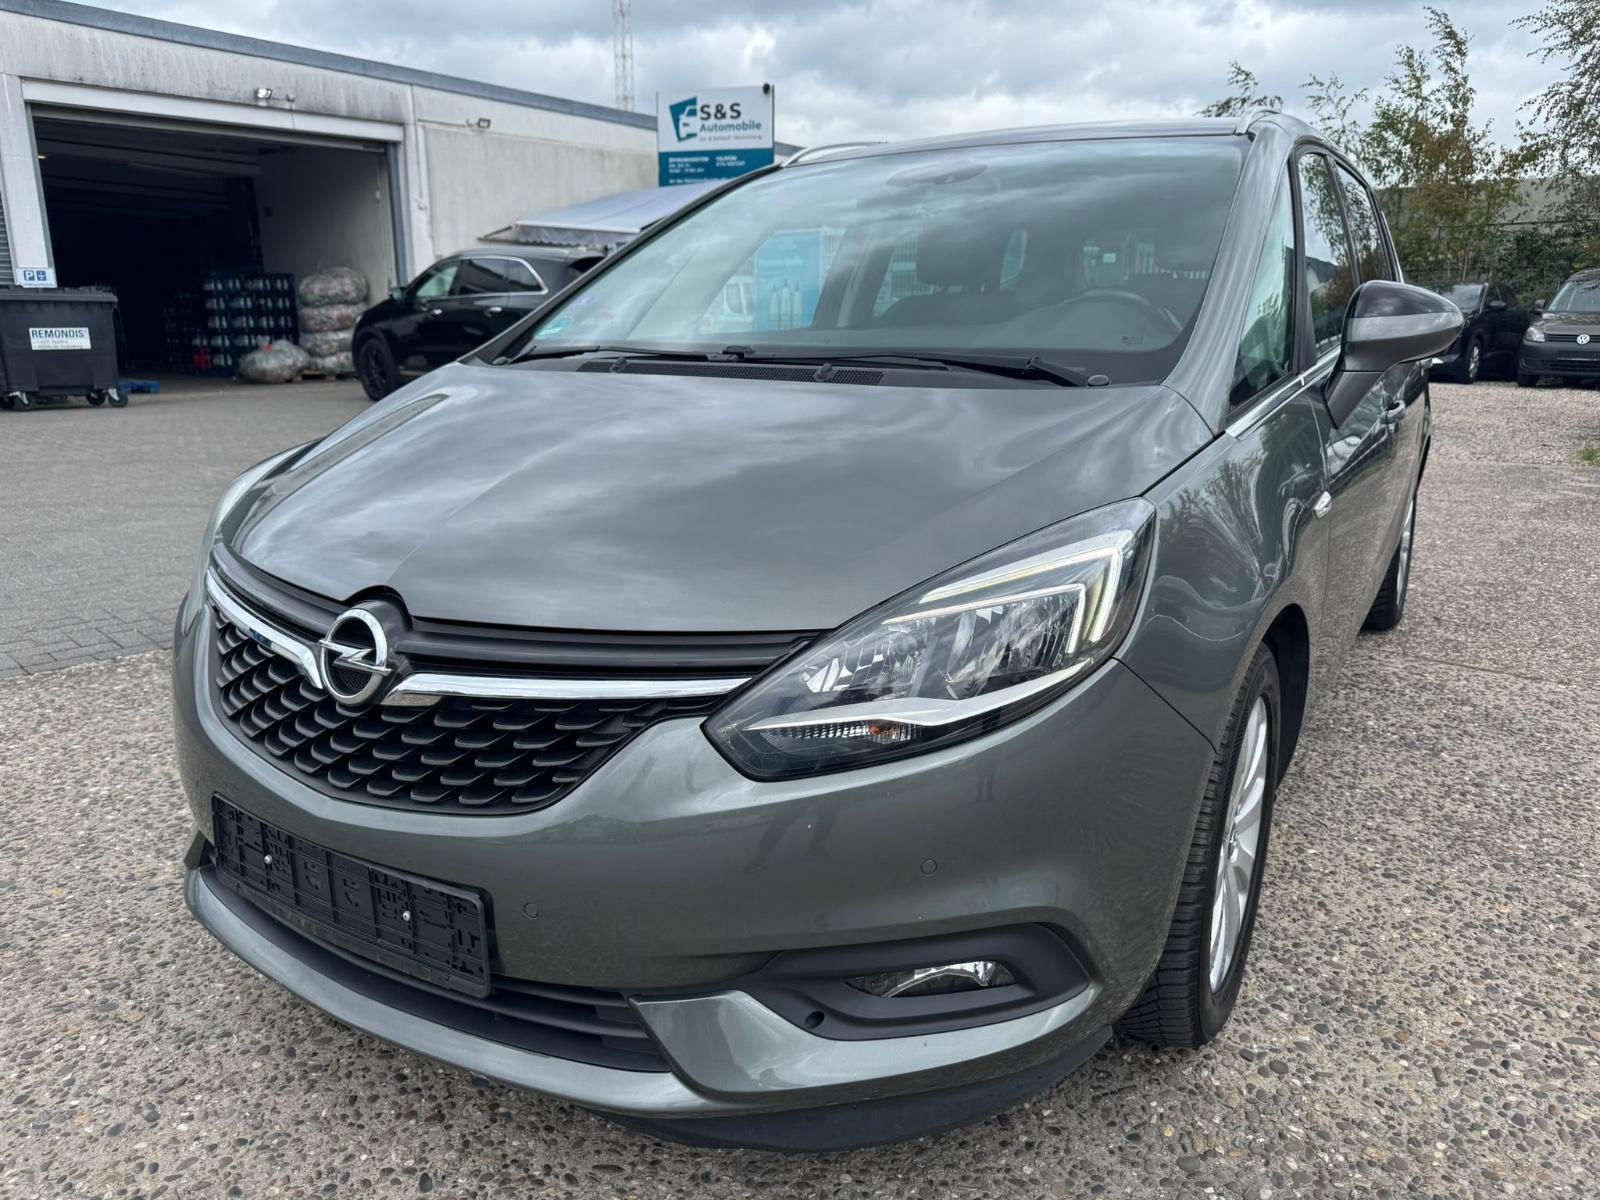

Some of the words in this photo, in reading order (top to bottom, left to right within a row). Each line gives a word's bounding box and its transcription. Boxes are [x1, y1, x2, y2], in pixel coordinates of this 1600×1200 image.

[700, 102, 742, 120] S&S
[699, 120, 762, 132] Automobile
[31, 329, 85, 338] REMONDIS
